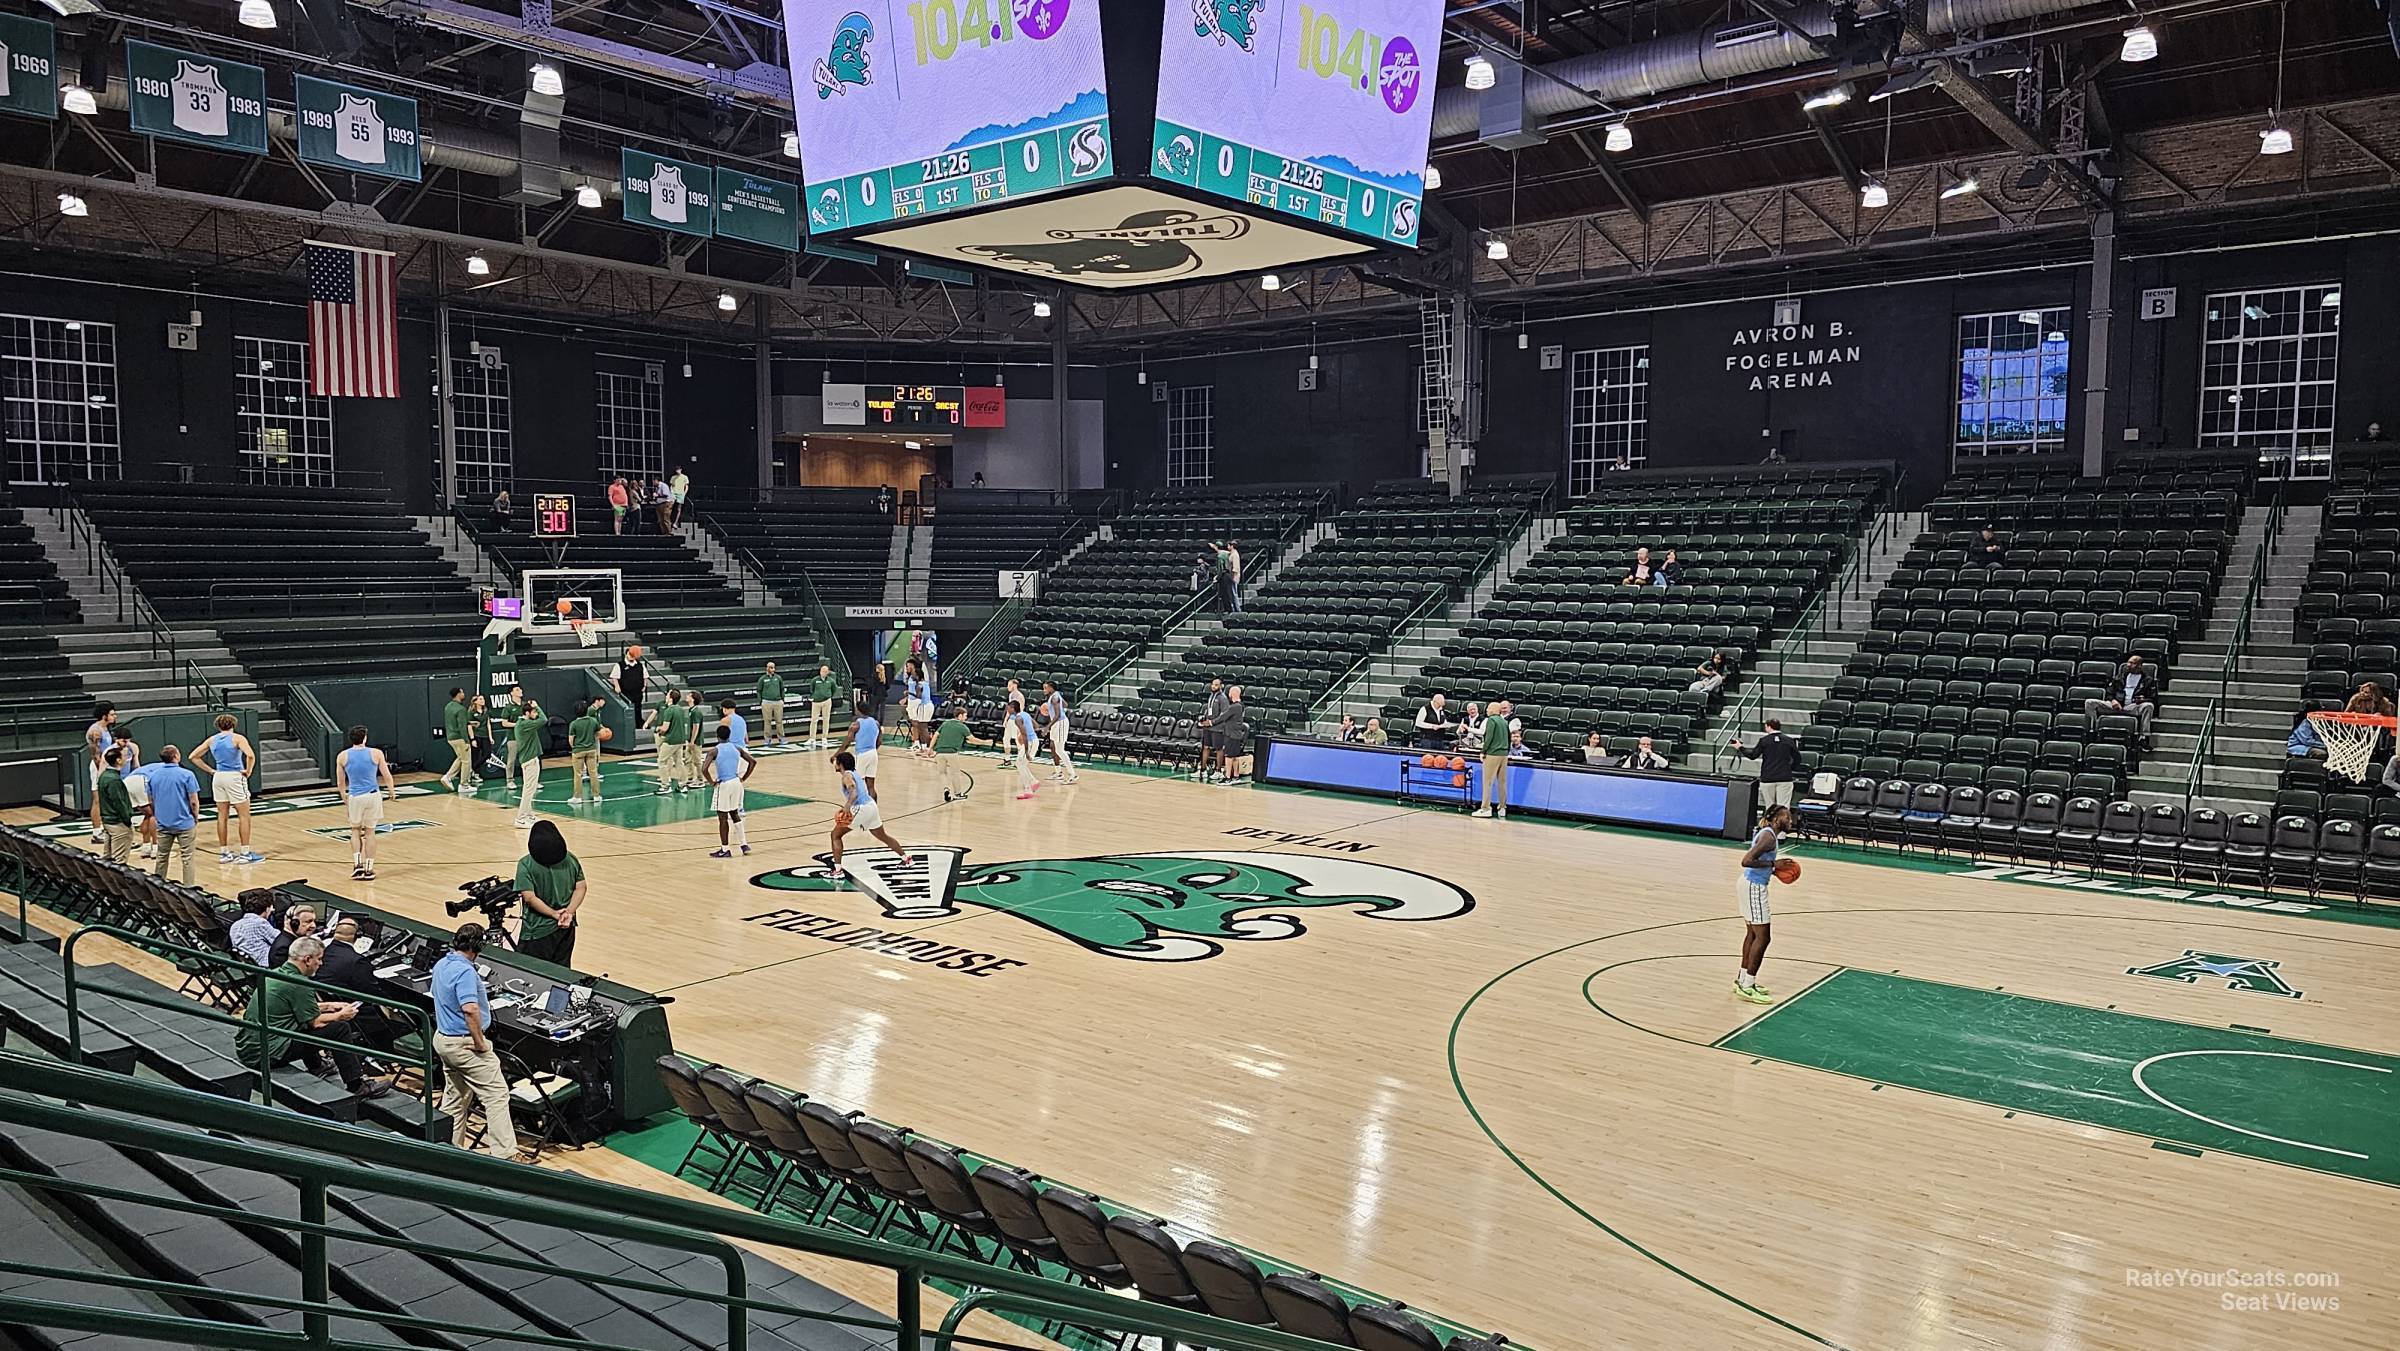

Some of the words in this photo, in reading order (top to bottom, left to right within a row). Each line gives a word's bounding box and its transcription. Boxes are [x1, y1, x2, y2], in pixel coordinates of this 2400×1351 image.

[1299, 5, 1382, 97] 104.1
[1394, 52, 1413, 67] THE
[12, 53, 49, 76] 1969
[1380, 65, 1420, 87] SPOT
[135, 76, 169, 98] 1980
[181, 81, 217, 94] THOMPSON
[189, 91, 211, 112] 33
[230, 96, 261, 117] 1983
[302, 109, 333, 129] 1989
[351, 123, 370, 142] 55
[387, 126, 415, 145] 1993
[1024, 140, 1040, 173] 0
[1218, 145, 1234, 177] 0
[920, 151, 971, 183] 21:26
[1280, 159, 1324, 191] 21:26
[627, 177, 649, 194] 1989
[974, 173, 991, 188] FLS
[998, 170, 1004, 182] 0
[1250, 176, 1265, 189] FLS
[1270, 182, 1277, 194] 0
[661, 188, 675, 205] 93
[688, 191, 709, 207] 1993
[861, 176, 876, 207] 0
[894, 189, 910, 204] FLS
[915, 188, 921, 199] 0
[936, 187, 959, 205] 1ST
[977, 187, 991, 200] TO
[999, 186, 1005, 197] 4
[1249, 191, 1260, 205] TO
[1268, 195, 1275, 208] 4
[896, 203, 909, 217] TO
[917, 201, 924, 213] 4
[1288, 194, 1309, 213] 1ST
[1322, 197, 1338, 210] FLS
[1340, 201, 1346, 213] 0
[1362, 188, 1375, 218] 0
[1321, 211, 1332, 223] TO
[1338, 216, 1345, 227] 4
[1093, 224, 1220, 237] TULANE
[2152, 299, 2165, 315] B
[178, 332, 188, 346] P
[1733, 324, 1815, 346] AVRON
[1829, 321, 1853, 338] B.
[485, 354, 497, 368] Q
[1546, 353, 1556, 366] T
[1726, 346, 1860, 372] FOGELMAN
[651, 370, 658, 382] R
[1304, 376, 1310, 388] S
[1750, 370, 1833, 391] ARENA
[896, 387, 933, 400] 21:26
[1157, 389, 1163, 399] R
[883, 409, 892, 423] 0
[950, 411, 959, 424] 0
[543, 512, 566, 532] 30
[491, 671, 518, 687] ROLL
[1220, 827, 1380, 852] DEVLIN
[1946, 860, 2329, 914] TULANE
[740, 908, 1028, 977] FIELDHOUSE
